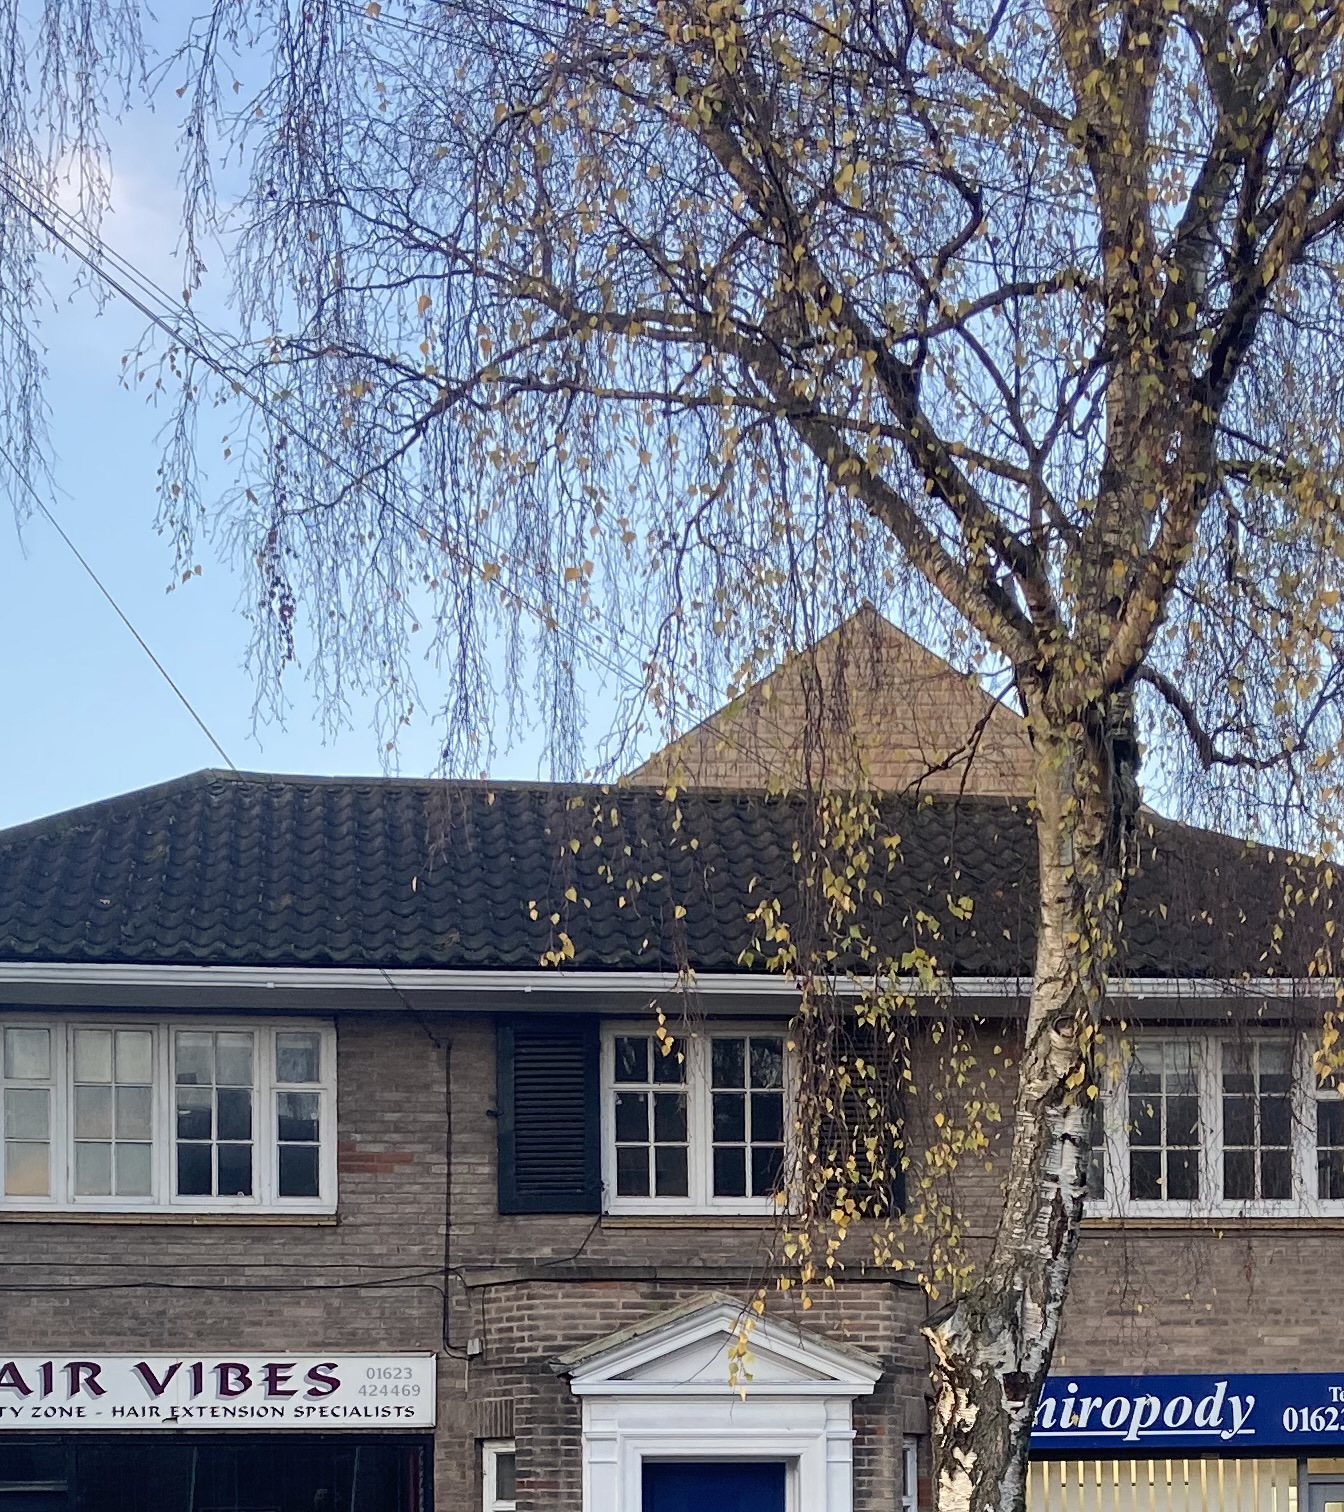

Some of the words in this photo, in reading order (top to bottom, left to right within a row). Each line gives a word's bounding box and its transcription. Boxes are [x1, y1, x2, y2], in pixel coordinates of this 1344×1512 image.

[132, 1361, 342, 1400] VIBES
[366, 1367, 413, 1380] 01623
[358, 1384, 421, 1398] 424469
[31, 1405, 88, 1419] ZONE
[112, 1405, 162, 1418] HAIR
[170, 1405, 285, 1419] EXTENSION
[293, 1405, 415, 1419] SPECIALISTS
[1031, 1380, 1256, 1442] hiropody
